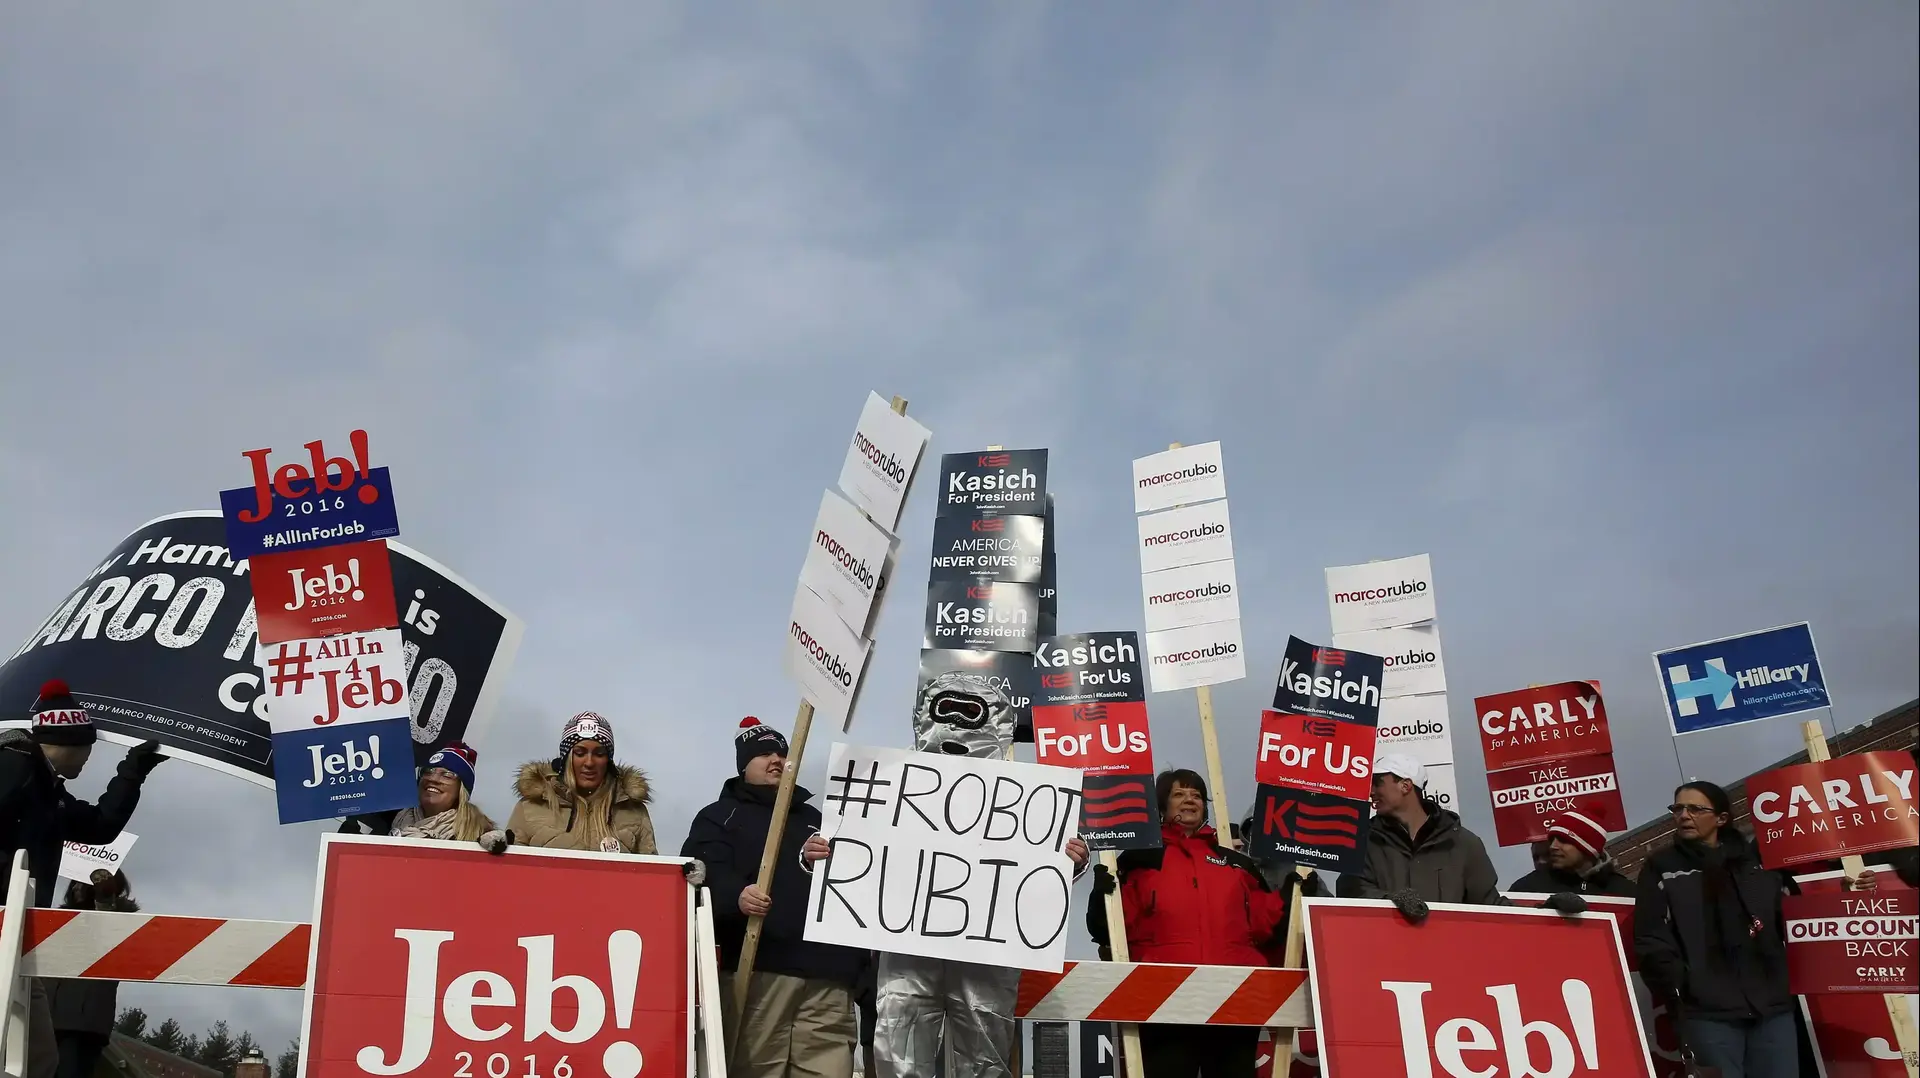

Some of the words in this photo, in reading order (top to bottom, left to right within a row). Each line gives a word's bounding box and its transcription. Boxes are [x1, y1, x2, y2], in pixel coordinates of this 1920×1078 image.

[854, 431, 905, 484] marcorubio
[238, 429, 379, 523] Jeb!
[949, 468, 1036, 492] Kasich
[1139, 462, 1218, 488] marcorubio
[285, 497, 345, 517] 2016
[948, 493, 968, 504] For
[972, 491, 1035, 503] President
[263, 520, 365, 548] #AllInForJeb
[951, 538, 1021, 552] AMERICA
[1144, 522, 1225, 547] marcorubio
[816, 529, 874, 590] marcorubio
[932, 556, 974, 568] NEVER
[978, 555, 1018, 567] GIVES
[284, 558, 365, 611] Jeb!
[1149, 582, 1231, 605] marcorubio
[1335, 578, 1427, 604] marcorubio
[311, 595, 345, 608] 2016
[404, 588, 441, 636] is
[936, 602, 1027, 624] Kasich
[311, 613, 348, 623] JEB2016.COM
[935, 625, 956, 637] For
[960, 625, 1026, 638] President
[791, 620, 852, 687] marcorubio
[1033, 637, 1135, 668] Kasich
[1154, 642, 1237, 665] marcorubio
[1384, 649, 1436, 667] orubio
[268, 642, 314, 697] #
[316, 638, 350, 660] All
[355, 637, 383, 655] In
[345, 658, 361, 681] 4
[1079, 670, 1105, 686] For
[1108, 669, 1131, 684] Us
[1736, 662, 1810, 689] Hillary
[1279, 657, 1380, 707] Kasich
[313, 664, 404, 726] Jeb
[1011, 696, 1030, 708] UP
[1743, 686, 1818, 706] hillaryclinton.com
[111, 707, 144, 719] MARCO
[145, 713, 174, 726] RUBIO
[175, 721, 195, 732] FOR
[196, 727, 248, 747] PRESIDENT
[1481, 694, 1597, 736] CARLY
[578, 724, 596, 733] Jeb!
[1037, 727, 1092, 757] For
[1100, 723, 1148, 754] Us
[1491, 739, 1505, 751] for
[1510, 723, 1600, 746] AMERICA
[302, 735, 384, 788] Jeb!
[1260, 731, 1316, 769] For
[1323, 741, 1369, 778] Us
[330, 773, 365, 785] 2016
[1529, 766, 1569, 783] TAKE
[330, 792, 366, 802] JEB2016.COM
[1497, 791, 1530, 805] OUR
[1533, 775, 1611, 799] COUNTRY
[1752, 769, 1914, 824] CARLY
[827, 760, 1082, 852] #ROBOT
[1534, 797, 1577, 815] BACK
[1766, 829, 1784, 844] for
[1792, 805, 1919, 837] AMERICA
[1275, 842, 1339, 861] JohnKasich.com
[817, 837, 1069, 950] RUBIO
[1841, 898, 1900, 915] TAKE
[1791, 923, 1839, 939] OUR
[1845, 941, 1909, 957] BACK
[1856, 967, 1906, 977] CARLY
[356, 928, 644, 1078] Jeb!
[454, 1051, 573, 1078] 2016
